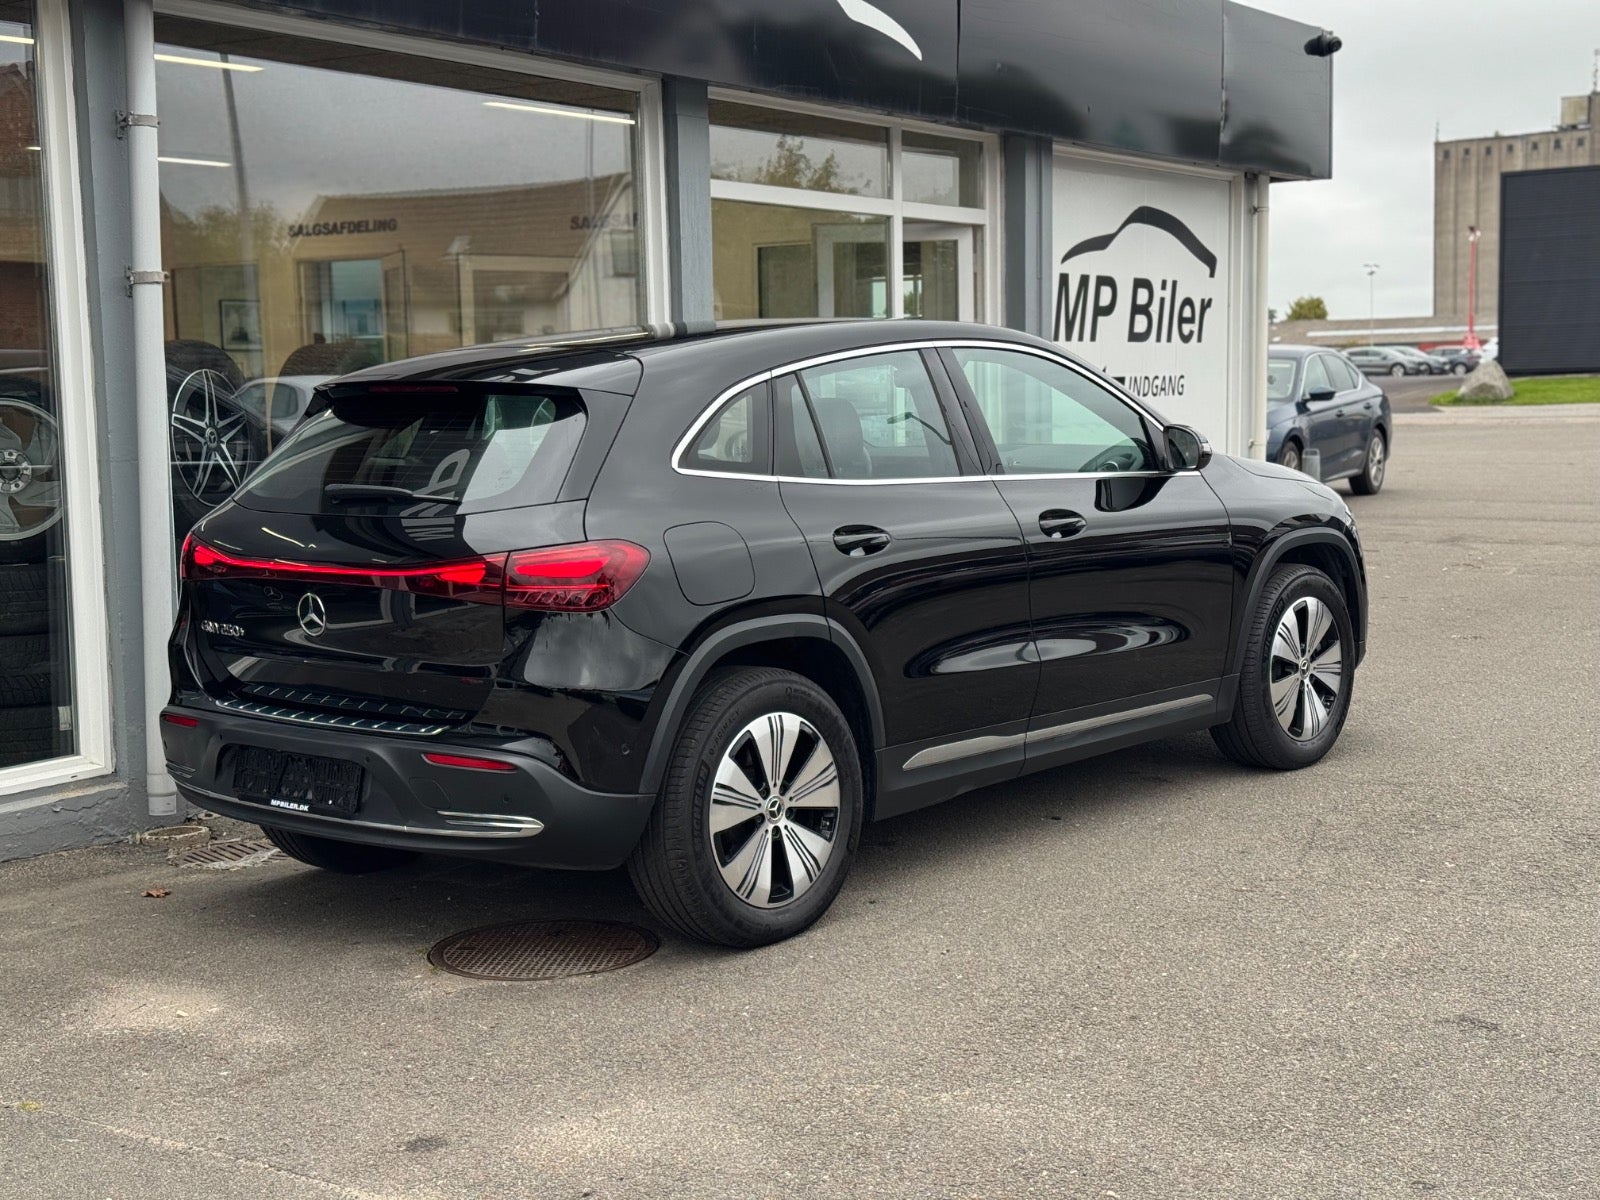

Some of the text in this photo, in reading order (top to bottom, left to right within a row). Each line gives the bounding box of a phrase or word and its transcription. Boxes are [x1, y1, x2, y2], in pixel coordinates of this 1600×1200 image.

[288, 218, 398, 237] SALGSAFDELING
[1053, 272, 1213, 344] MP Biler
[1128, 375, 1185, 397] INDGANG
[271, 799, 309, 812] MPBILER.DK
